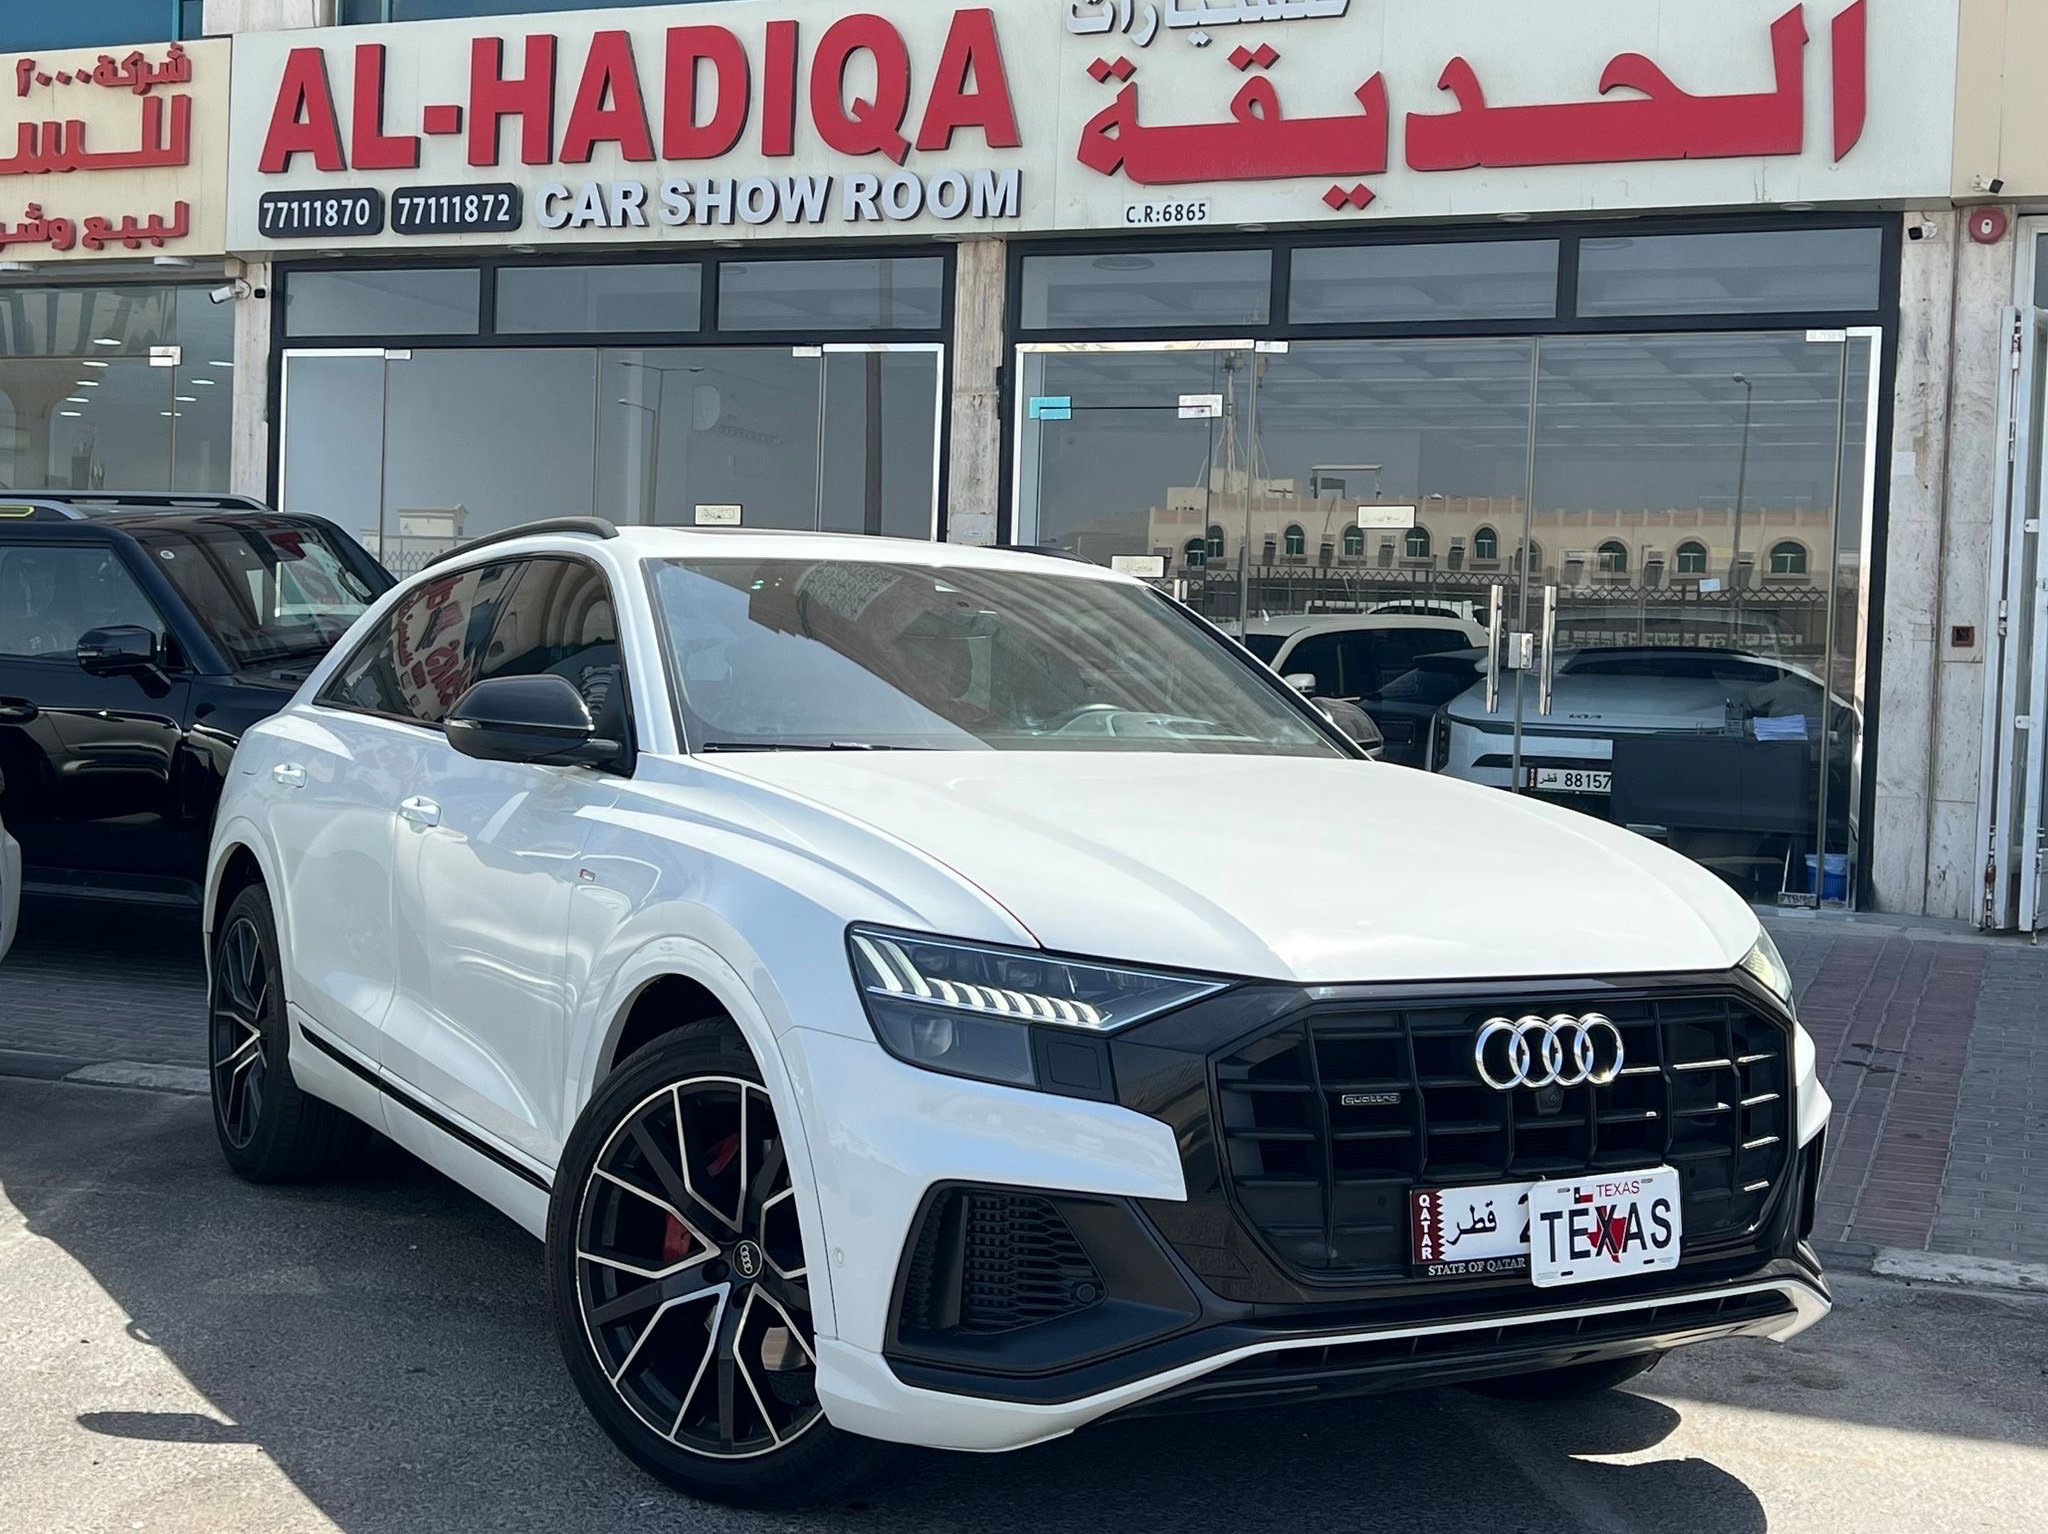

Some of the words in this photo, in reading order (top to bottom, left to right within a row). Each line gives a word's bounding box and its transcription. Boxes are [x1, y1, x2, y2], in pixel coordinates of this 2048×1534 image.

[92, 41, 192, 96] شركة
[258, 8, 1022, 174] AL-HADIQA
[1076, 0, 1868, 212] الحديقة
[263, 198, 370, 229] 77111870
[398, 194, 511, 225] 77111872
[535, 180, 650, 229] CAR
[658, 174, 832, 226] SHOW
[842, 168, 1022, 222] ROOM
[1126, 203, 1206, 223] C.R:6865
[82, 200, 190, 250] لبيع
[1539, 773, 1558, 785] قطر
[1564, 772, 1612, 790] 88157
[1345, 1095, 1397, 1104] quattro
[1596, 1180, 1641, 1198] TEXAS
[1418, 1194, 1433, 1260] QATAR
[1445, 1200, 1497, 1246] قطر
[1539, 1197, 1673, 1263] TEXAS
[1428, 1263, 1466, 1276] STATE
[1468, 1261, 1485, 1273] OF
[1486, 1257, 1526, 1271] QATAR
